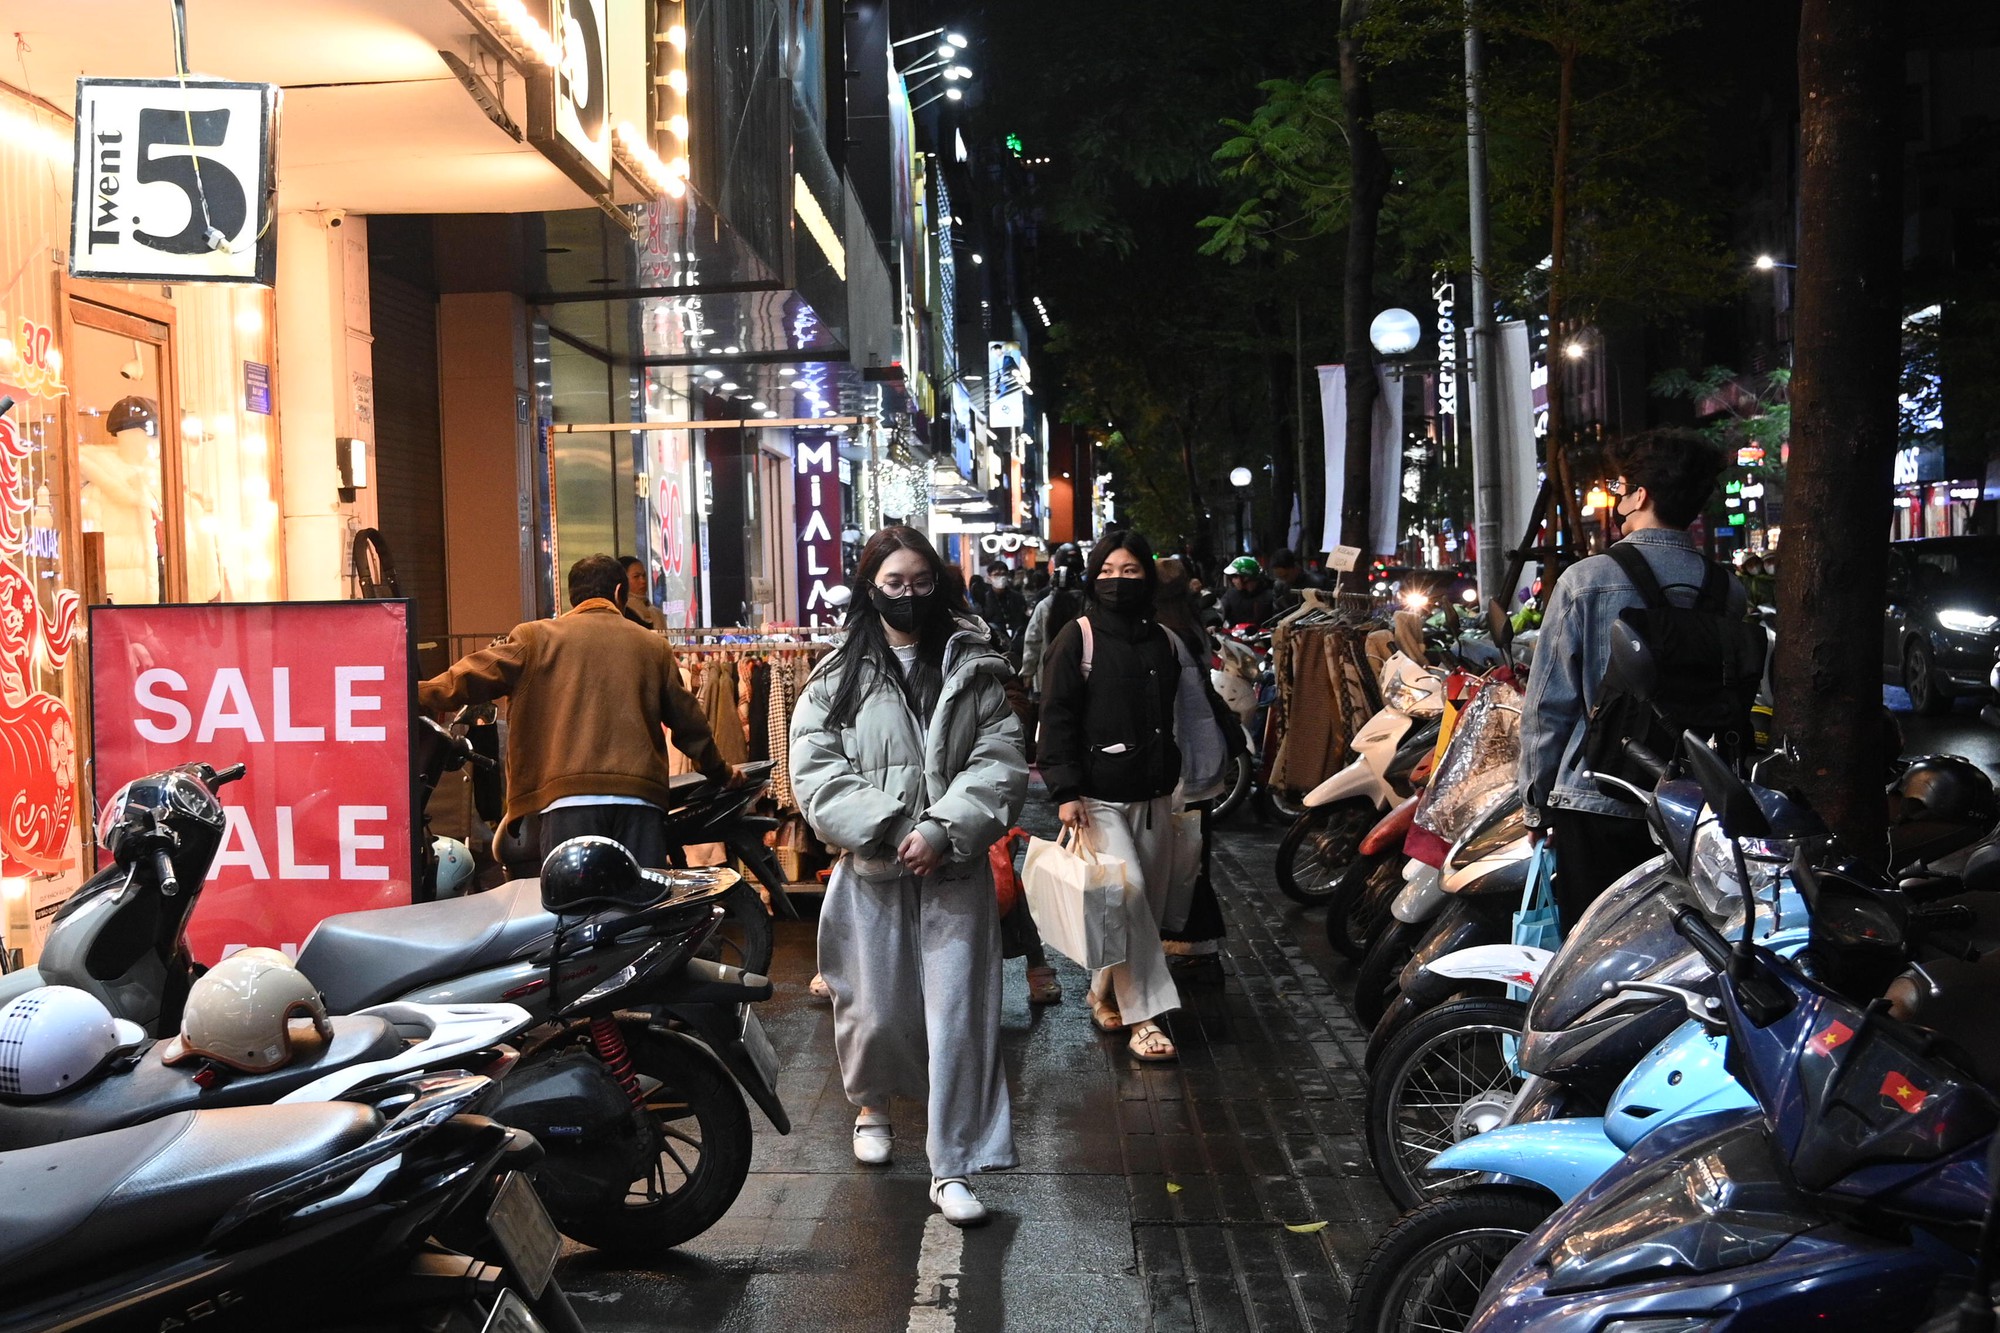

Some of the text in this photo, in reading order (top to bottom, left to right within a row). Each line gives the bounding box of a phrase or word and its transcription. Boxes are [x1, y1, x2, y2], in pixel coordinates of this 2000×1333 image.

[90, 100, 123, 254] Twent
[134, 665, 386, 743] SALE
[205, 805, 390, 881] ALE
[1696, 1157, 1719, 1198] HONDA
